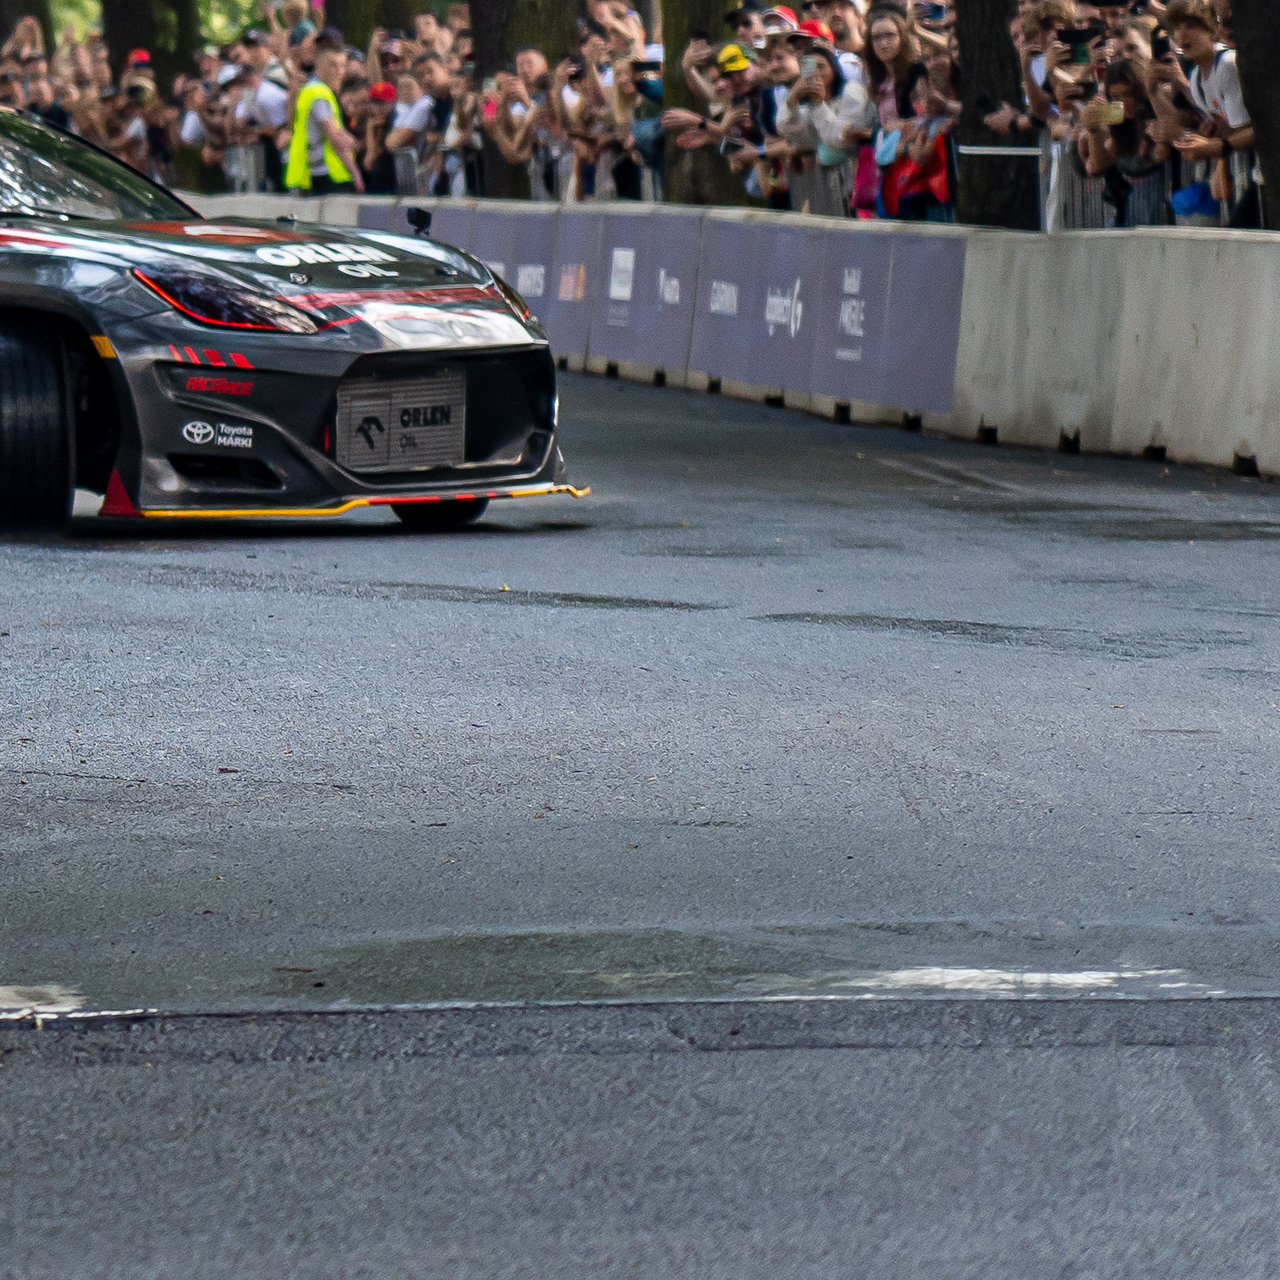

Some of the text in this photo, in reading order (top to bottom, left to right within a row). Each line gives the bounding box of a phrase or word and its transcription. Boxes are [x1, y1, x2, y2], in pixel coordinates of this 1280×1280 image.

[256, 243, 399, 267] ORLEN
[337, 263, 400, 278] OIL
[400, 404, 452, 429] ORLEN
[219, 423, 253, 437] Toyota
[216, 435, 253, 449] MARKI
